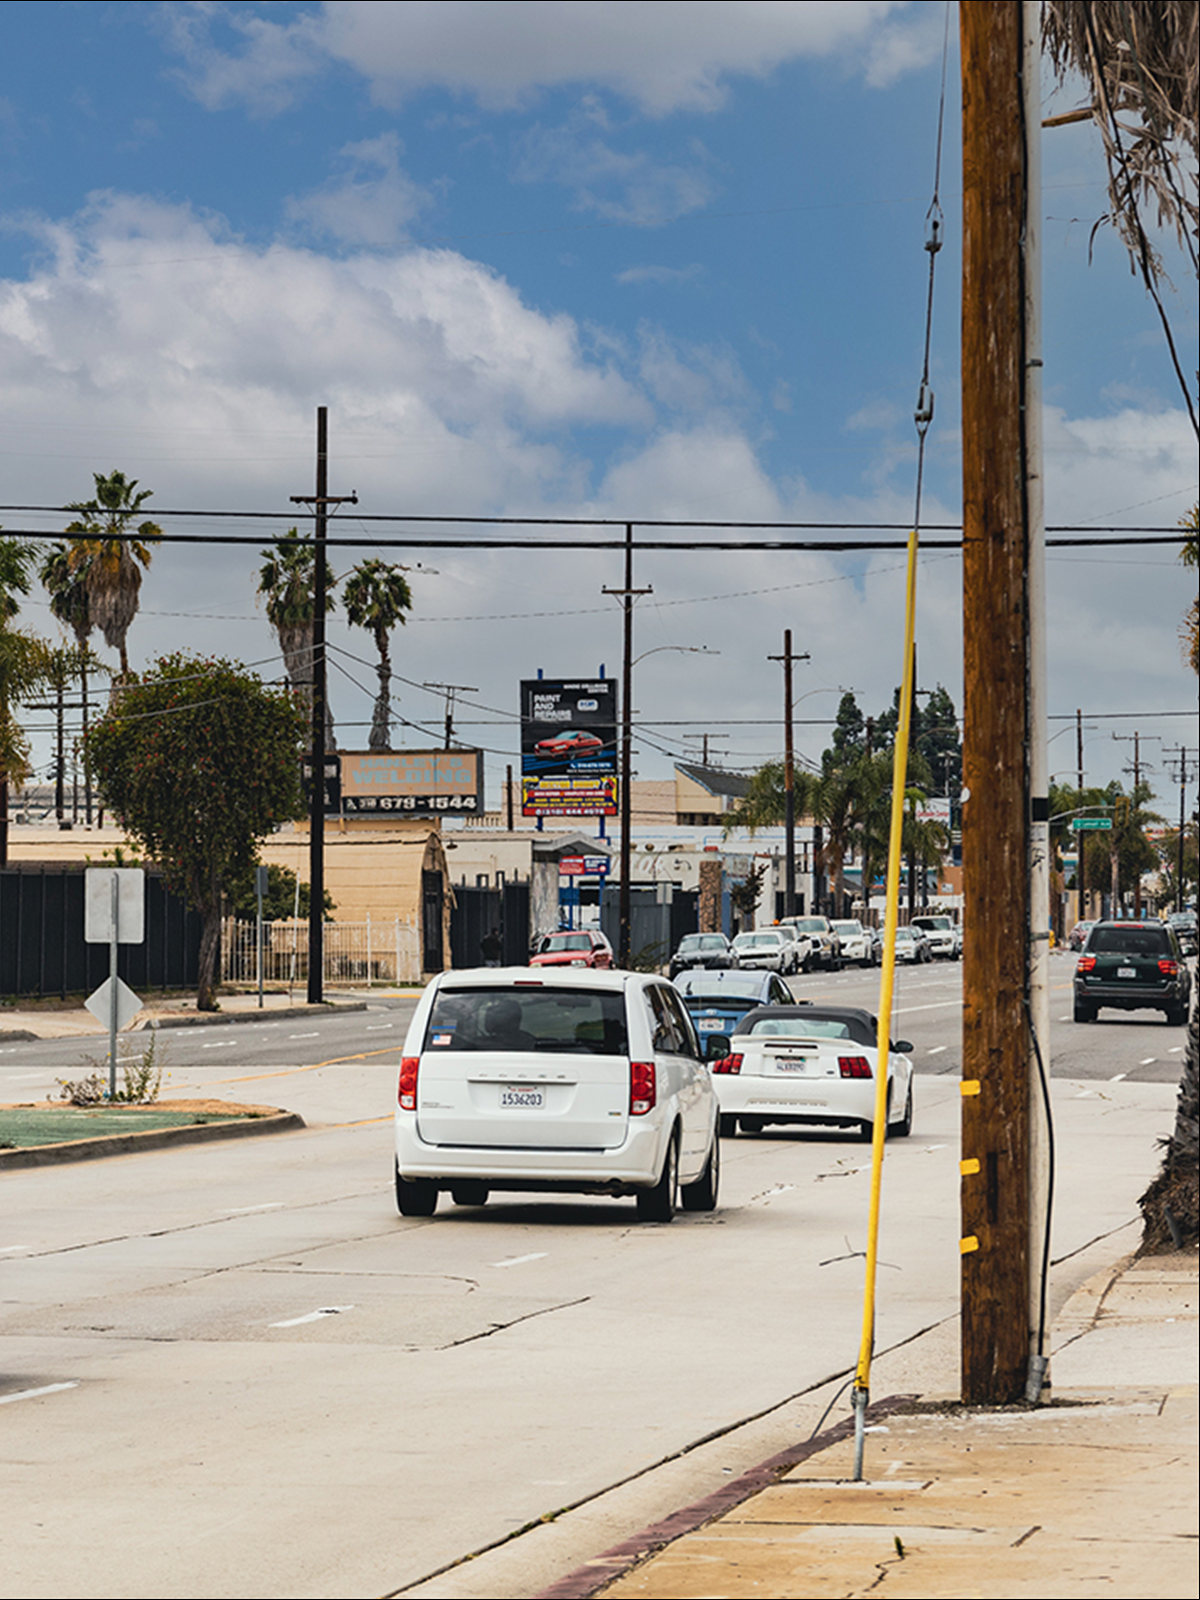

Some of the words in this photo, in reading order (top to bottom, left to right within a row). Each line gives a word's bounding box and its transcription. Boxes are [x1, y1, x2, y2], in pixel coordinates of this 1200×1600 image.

[534, 694, 561, 702] PAINT
[534, 702, 554, 711] AND
[359, 757, 463, 769] HANLEY'S
[352, 769, 472, 784] WELDING
[502, 1093, 543, 1106] 1536203
